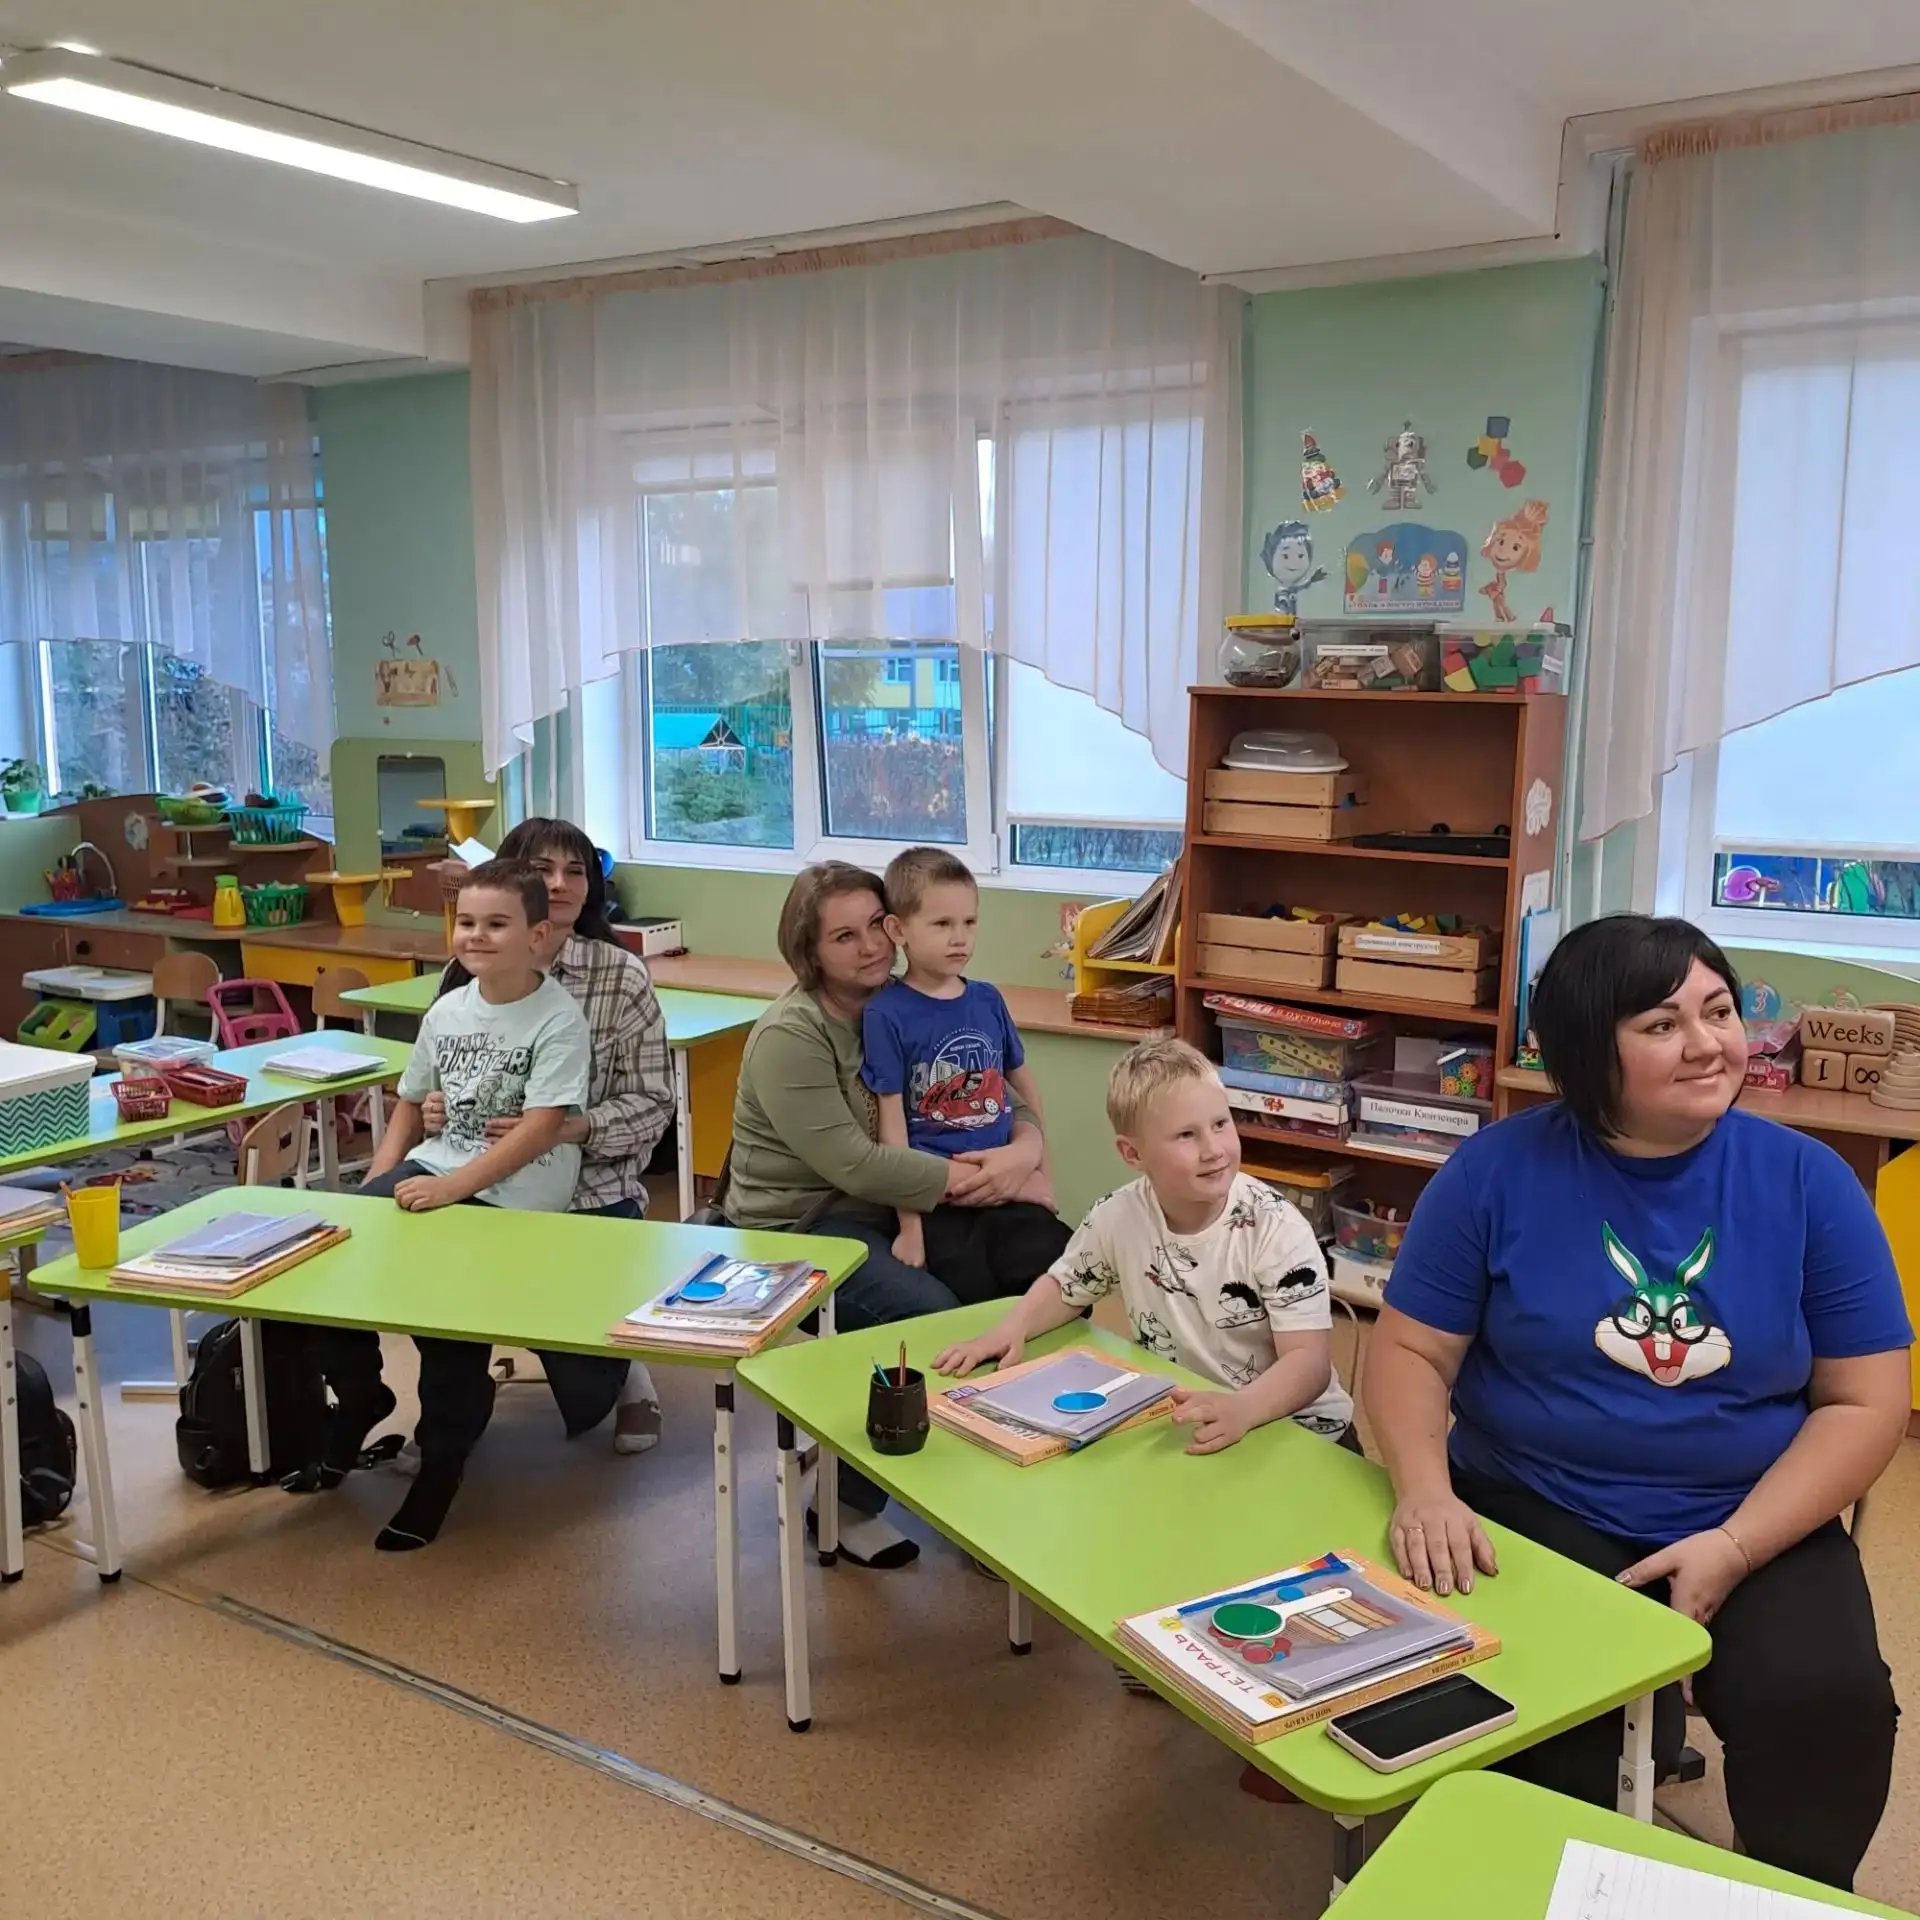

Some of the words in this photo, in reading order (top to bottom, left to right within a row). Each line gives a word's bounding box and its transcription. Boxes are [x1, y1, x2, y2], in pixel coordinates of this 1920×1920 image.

[1807, 1020, 1885, 1046] Weeks
[1370, 1101, 1411, 1117] Палочки
[1173, 1633, 1255, 1695] ТЕТРАДЬ
